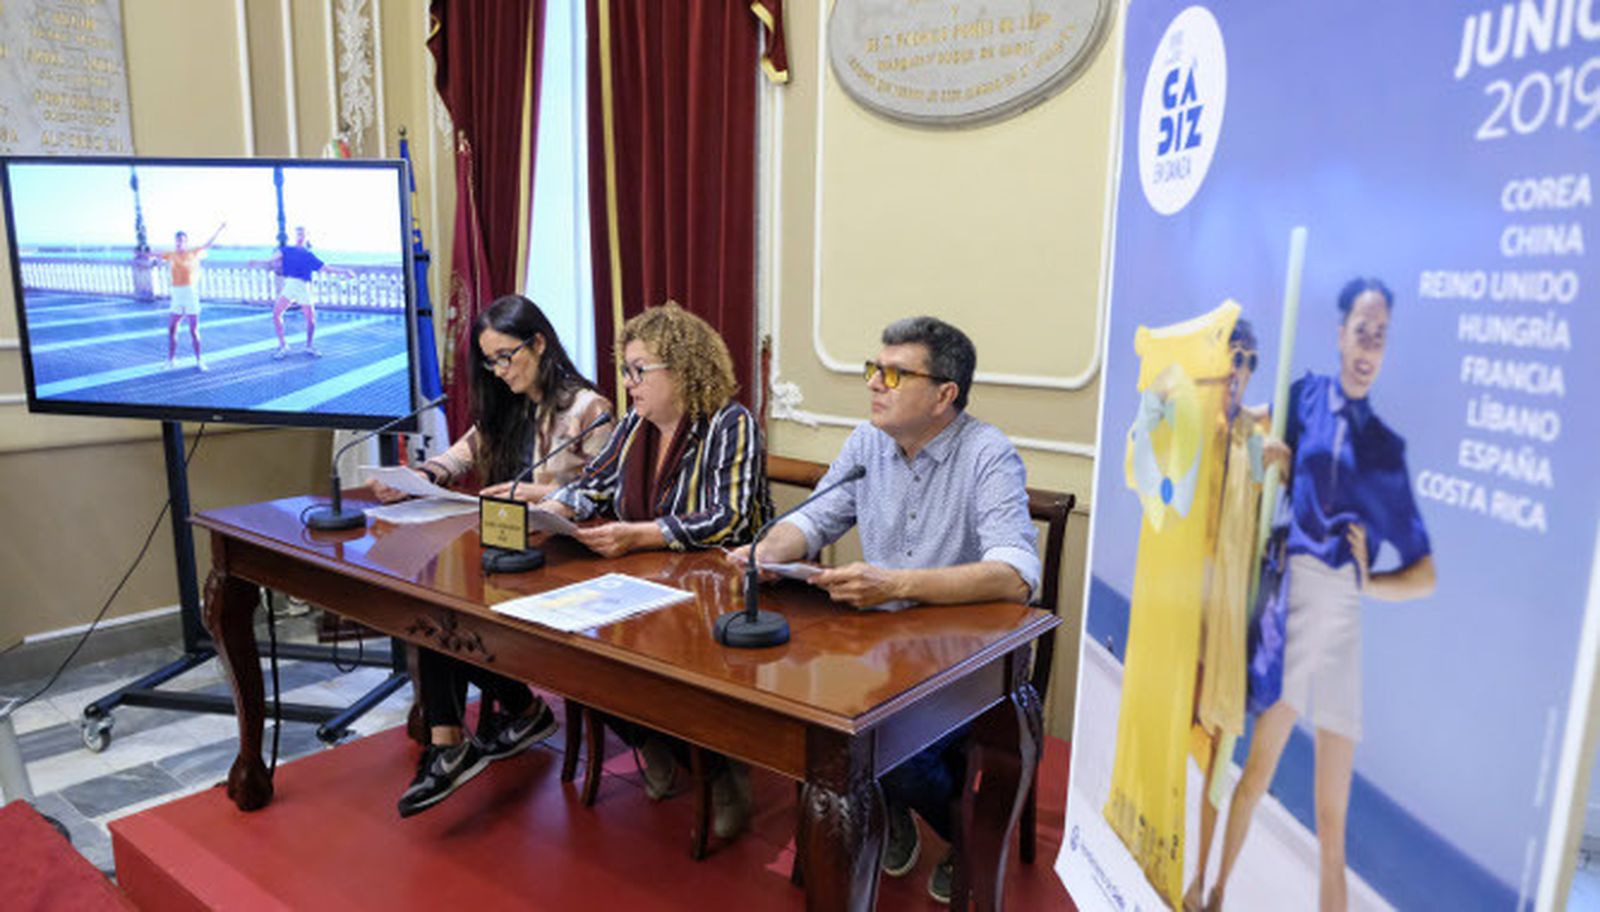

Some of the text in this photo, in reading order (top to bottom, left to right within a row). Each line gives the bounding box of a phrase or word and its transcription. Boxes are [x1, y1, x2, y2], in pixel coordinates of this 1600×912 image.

[1476, 57, 1600, 140] 2019
[1501, 173, 1593, 212] COREA
[1500, 221, 1585, 257] CHINA
[1419, 269, 1580, 304] REINO UNIDO
[1457, 309, 1572, 351] HUNGRÍA
[1459, 354, 1566, 398] FRANCIA
[1466, 393, 1561, 442] LÍBANO
[1457, 438, 1555, 489] ESPAÑA
[1416, 468, 1547, 534] COSTA RICA
